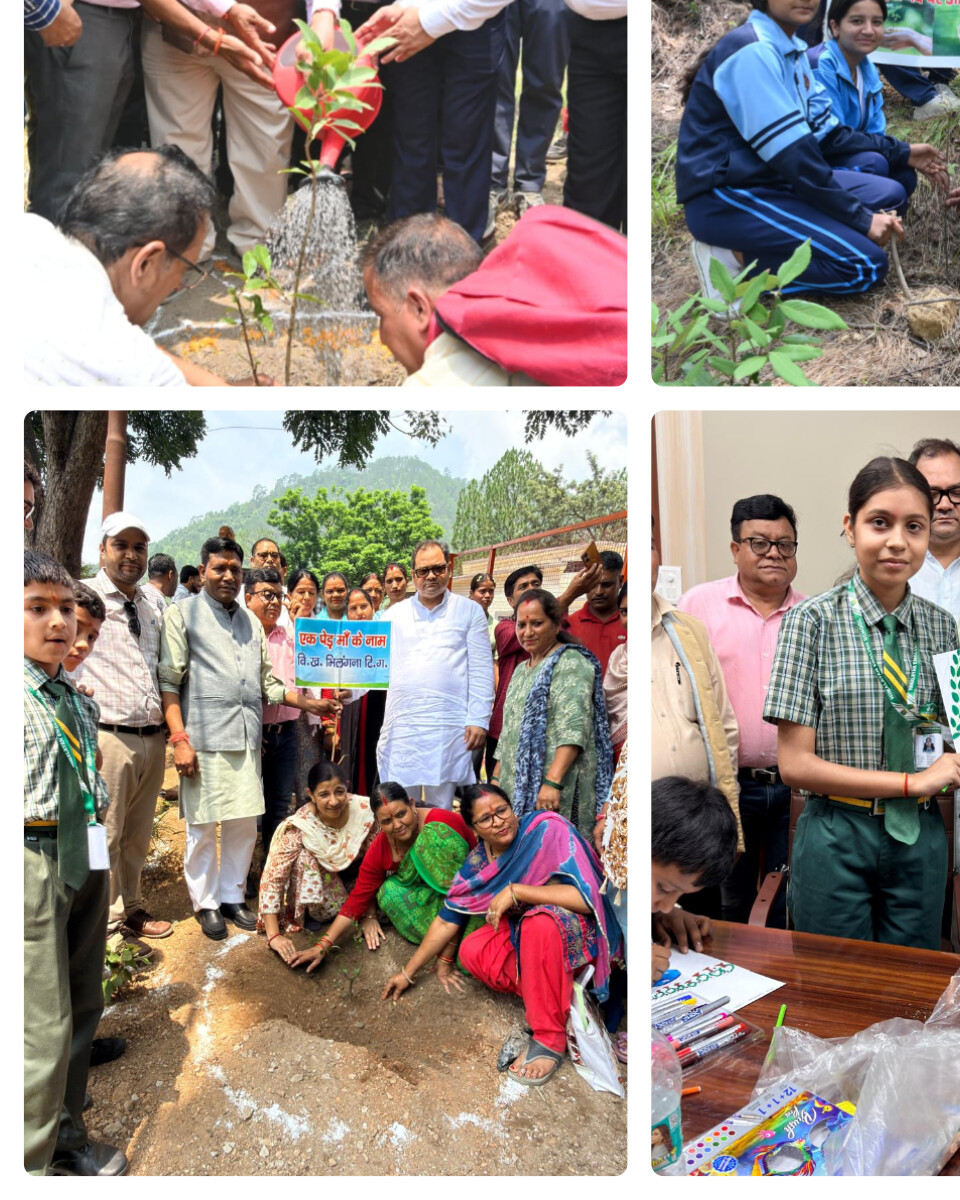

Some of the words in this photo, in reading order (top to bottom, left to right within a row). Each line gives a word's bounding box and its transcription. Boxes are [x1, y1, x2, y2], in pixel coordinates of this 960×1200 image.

[299, 632, 317, 645] एक
[319, 629, 334, 649] पेड़
[336, 630, 350, 647] माँ
[351, 631, 363, 647] के
[365, 635, 387, 647] नाम
[325, 654, 361, 668] भिलंगना
